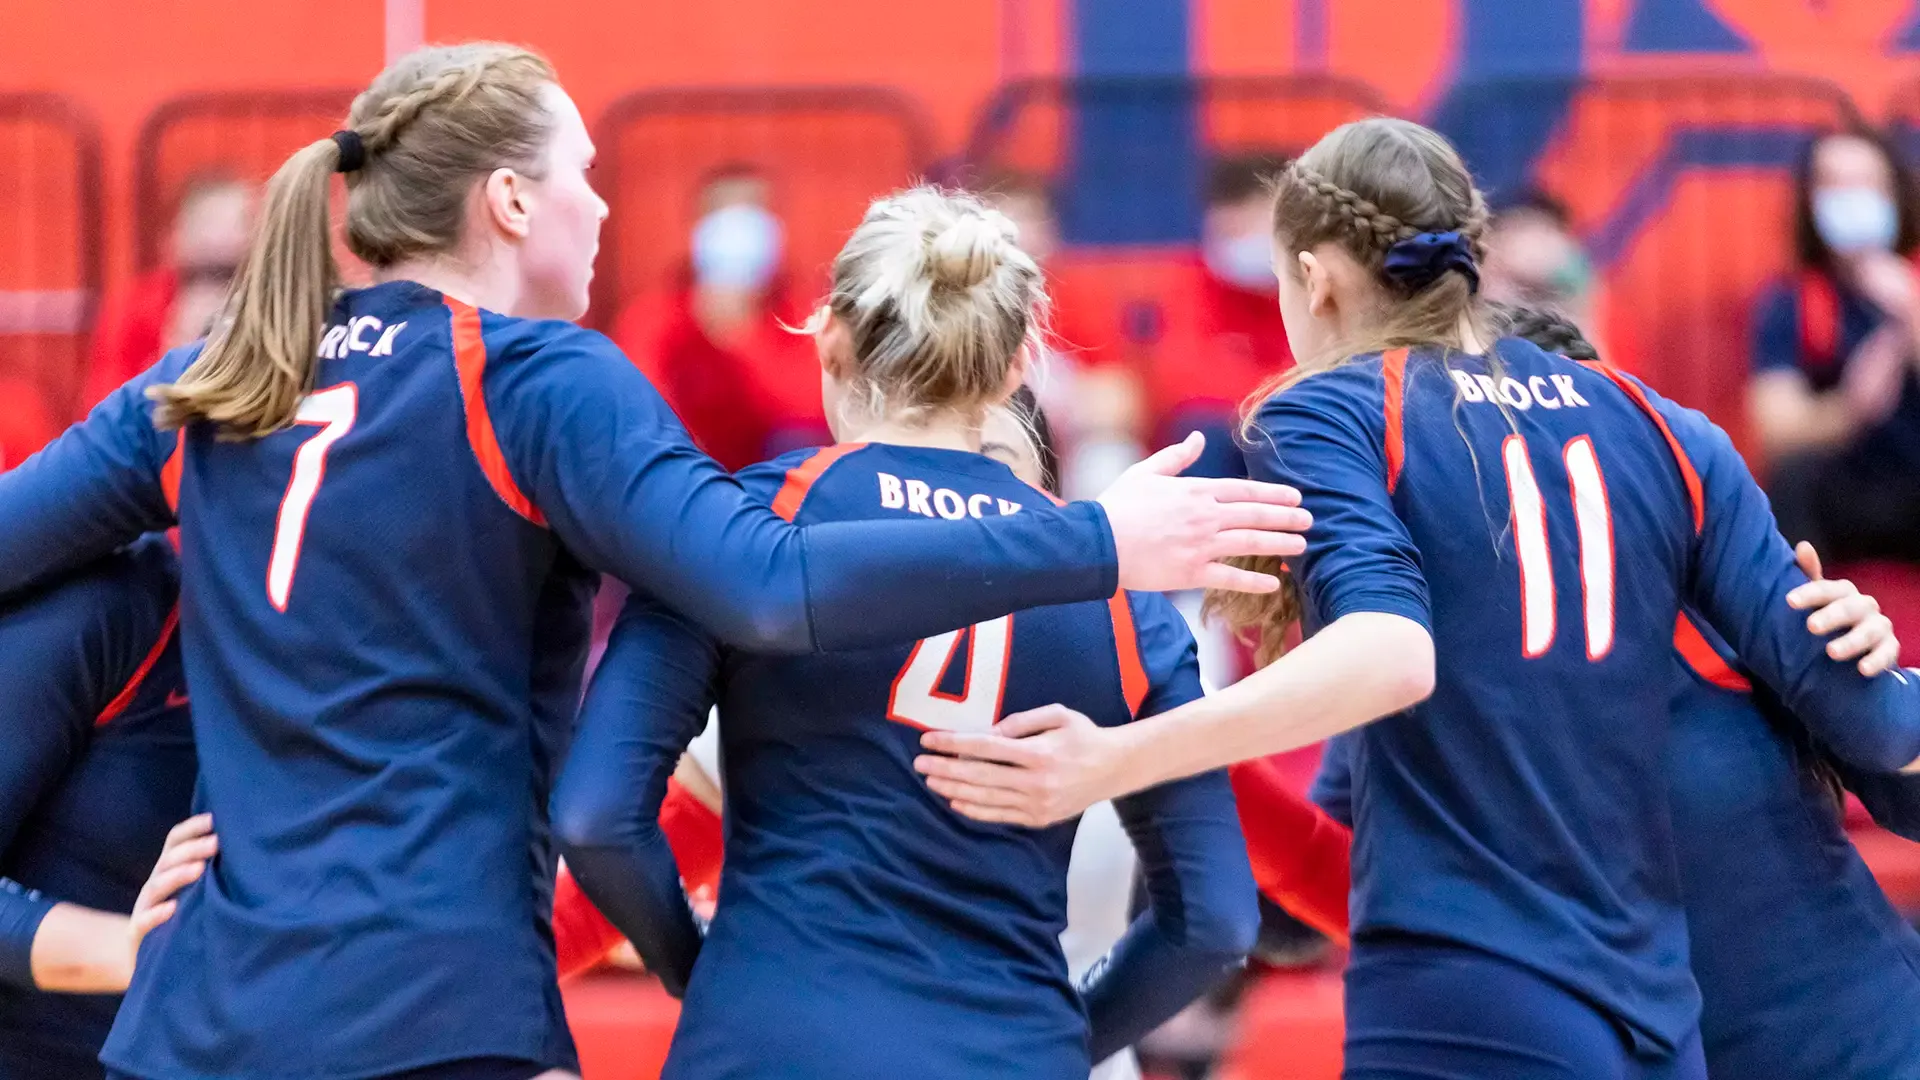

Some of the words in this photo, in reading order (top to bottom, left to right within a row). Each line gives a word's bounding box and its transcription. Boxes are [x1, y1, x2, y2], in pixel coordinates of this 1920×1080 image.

[317, 315, 408, 359] RCK
[1451, 369, 1590, 411] BROCK
[266, 381, 358, 612] 7
[1502, 434, 1615, 661] 11
[886, 613, 1014, 733] 4
